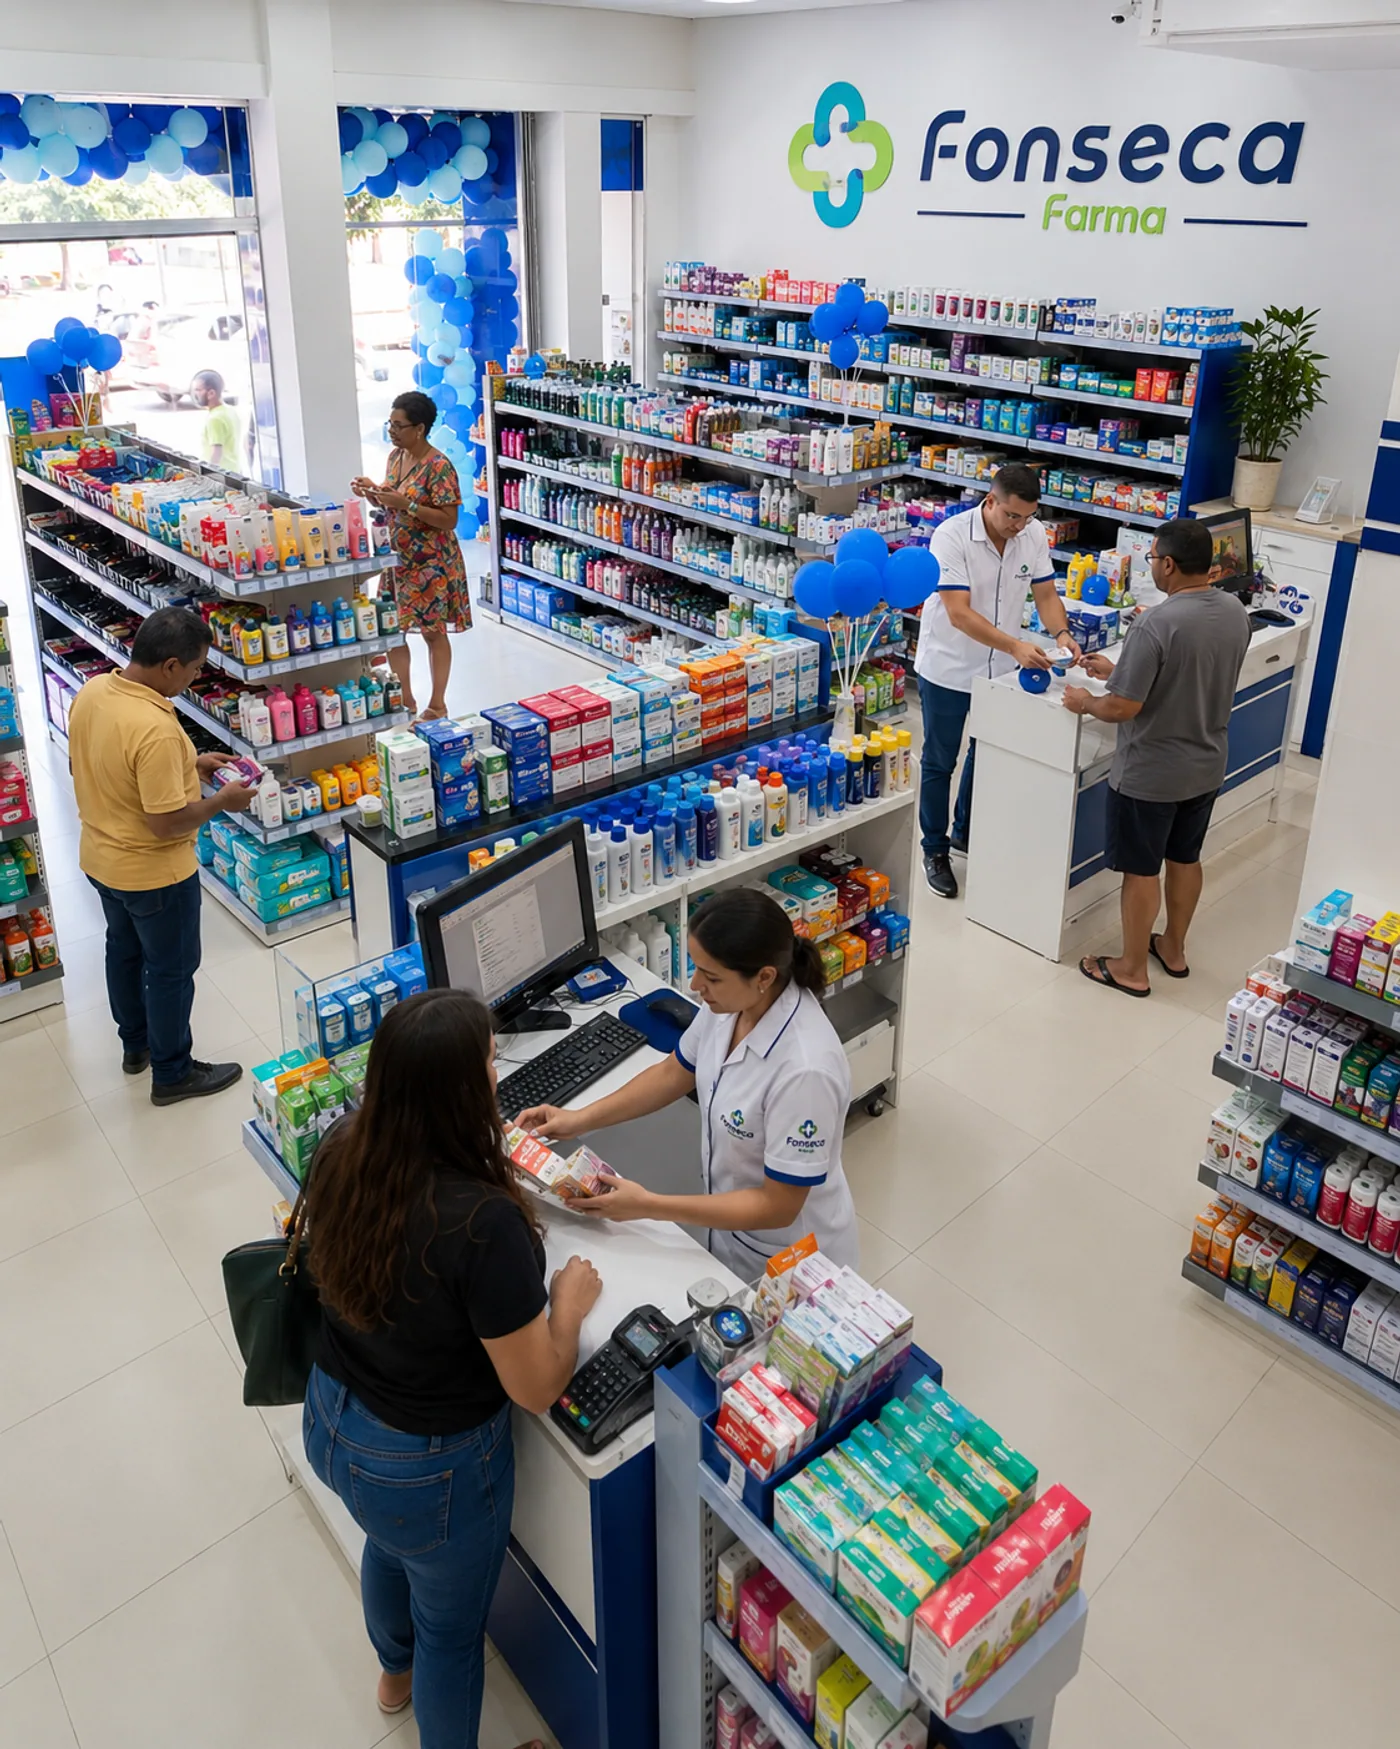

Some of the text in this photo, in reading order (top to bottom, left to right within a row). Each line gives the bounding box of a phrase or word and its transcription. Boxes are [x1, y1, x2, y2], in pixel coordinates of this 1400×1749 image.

[920, 109, 1305, 184] Fonseca
[1042, 193, 1167, 235] Farma
[786, 1136, 826, 1148] Fonseca
